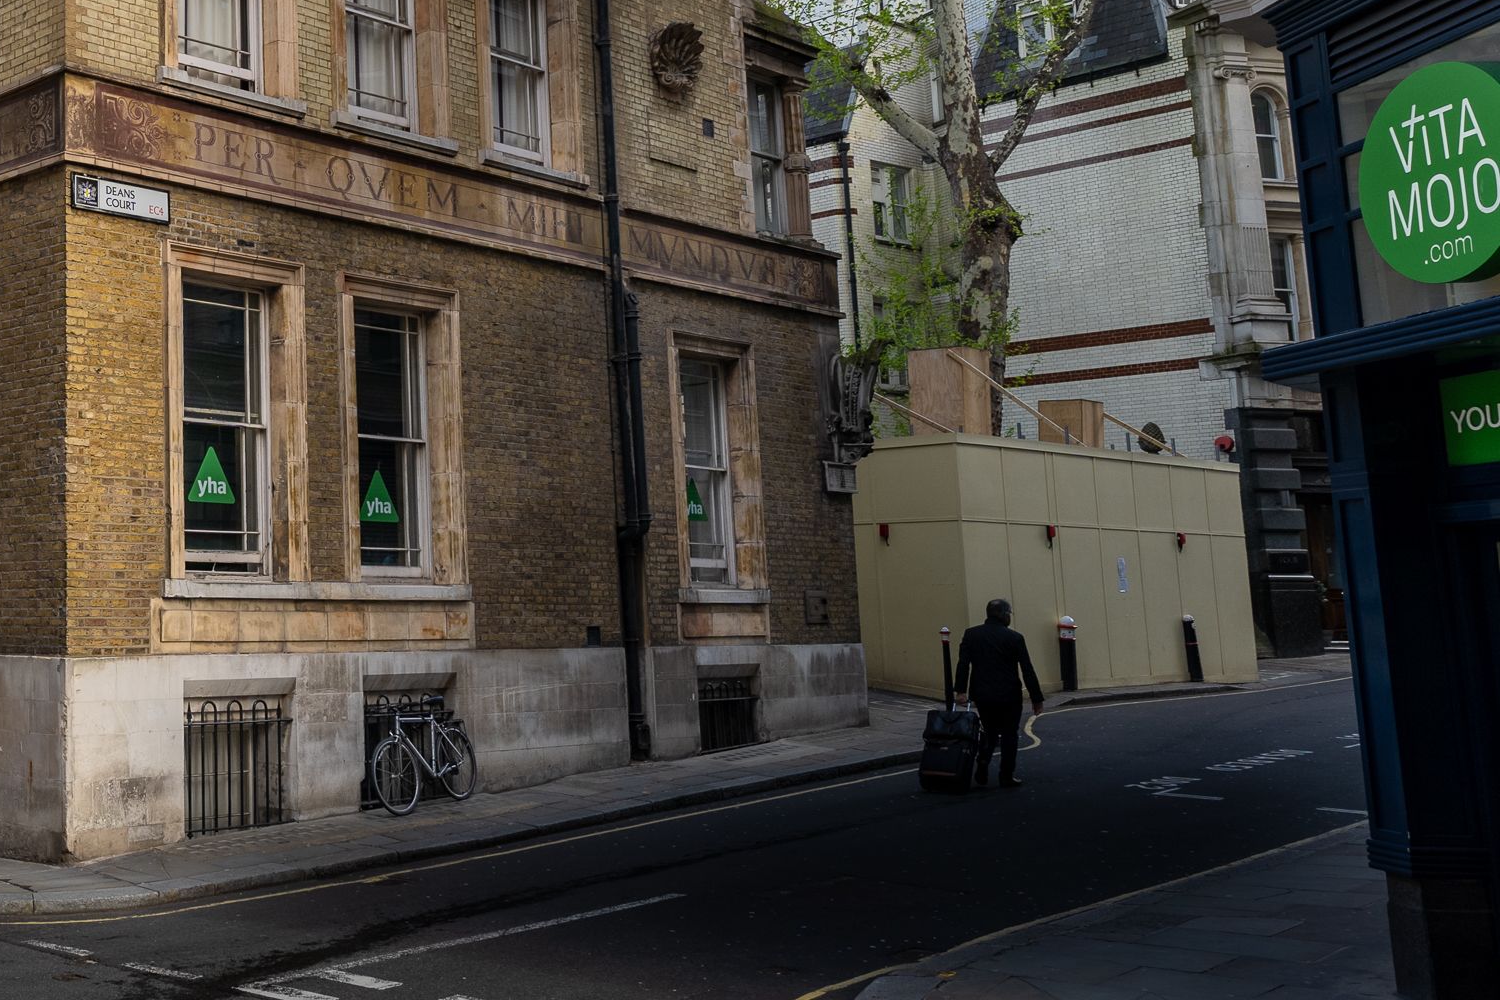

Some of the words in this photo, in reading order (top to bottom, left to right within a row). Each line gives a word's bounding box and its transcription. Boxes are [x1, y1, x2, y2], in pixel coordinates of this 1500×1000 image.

[1388, 97, 1487, 174] VITA
[194, 122, 282, 186] PER
[325, 155, 459, 218] QVEM
[105, 185, 136, 200] DEANS
[105, 197, 137, 211] COURT
[1387, 157, 1500, 241] MOJO
[148, 205, 165, 217] EC4
[1423, 234, 1474, 265] .com
[1449, 402, 1500, 434] YOU
[197, 476, 227, 498] yha
[366, 497, 392, 517] yha
